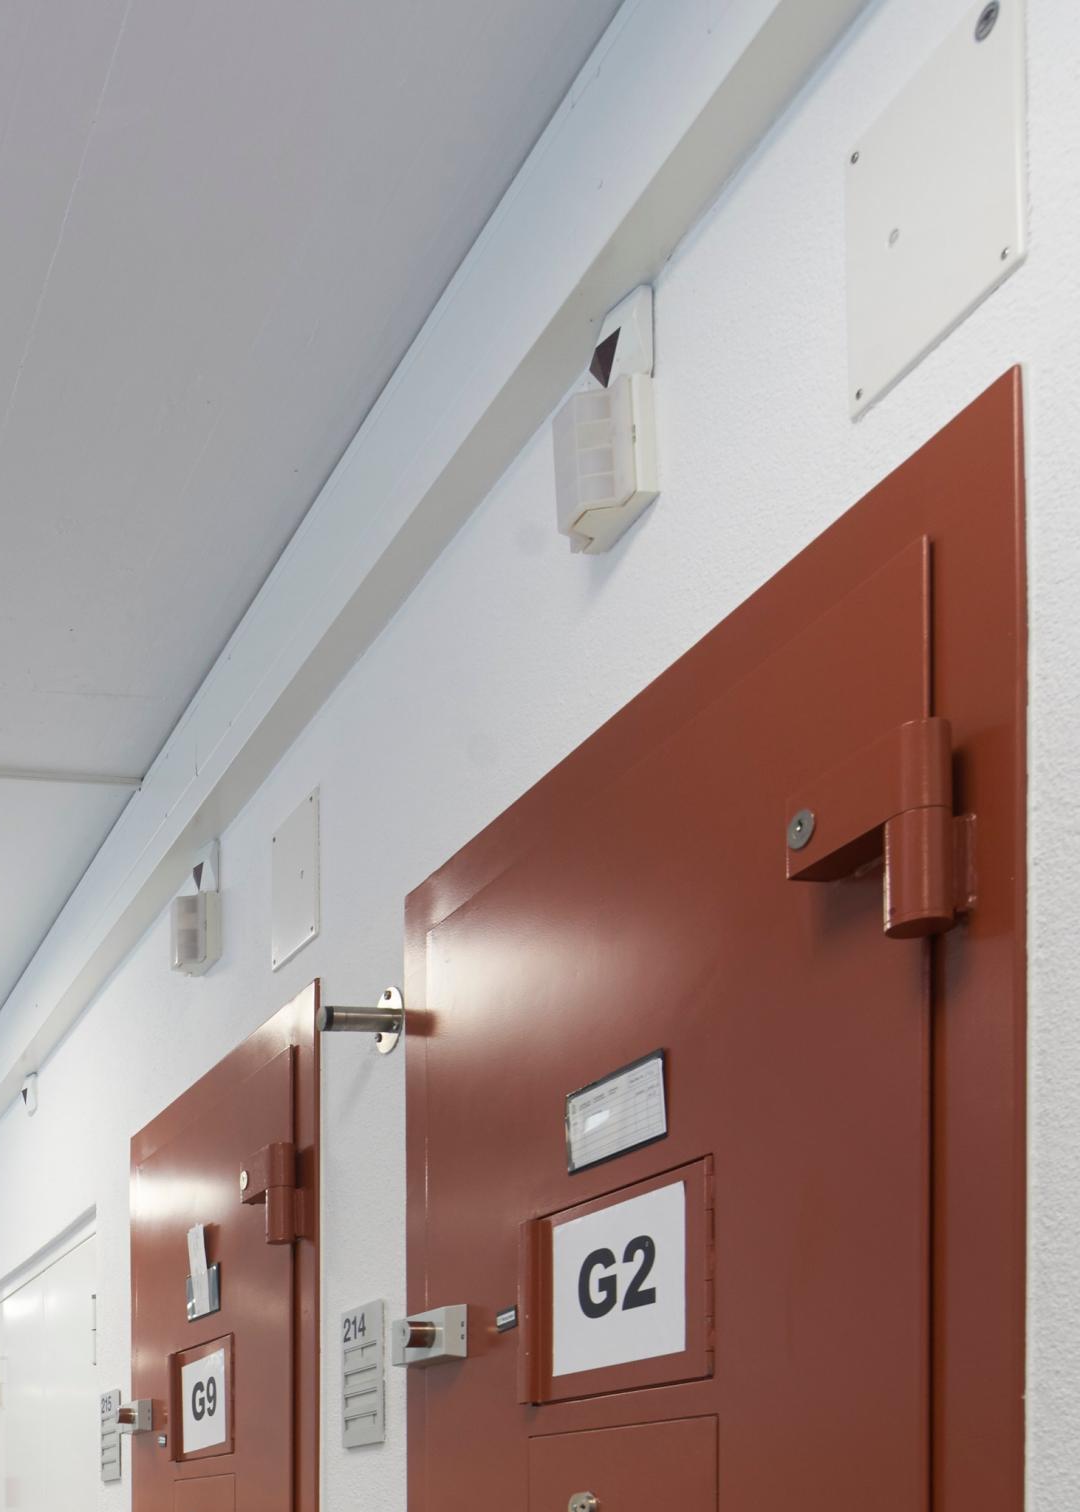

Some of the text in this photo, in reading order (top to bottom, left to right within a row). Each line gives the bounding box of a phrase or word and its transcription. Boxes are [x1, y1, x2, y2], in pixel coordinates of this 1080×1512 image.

[577, 1234, 657, 1319] G2
[343, 1312, 366, 1343] 214
[101, 1395, 112, 1414] 215
[192, 1376, 217, 1421] G9
